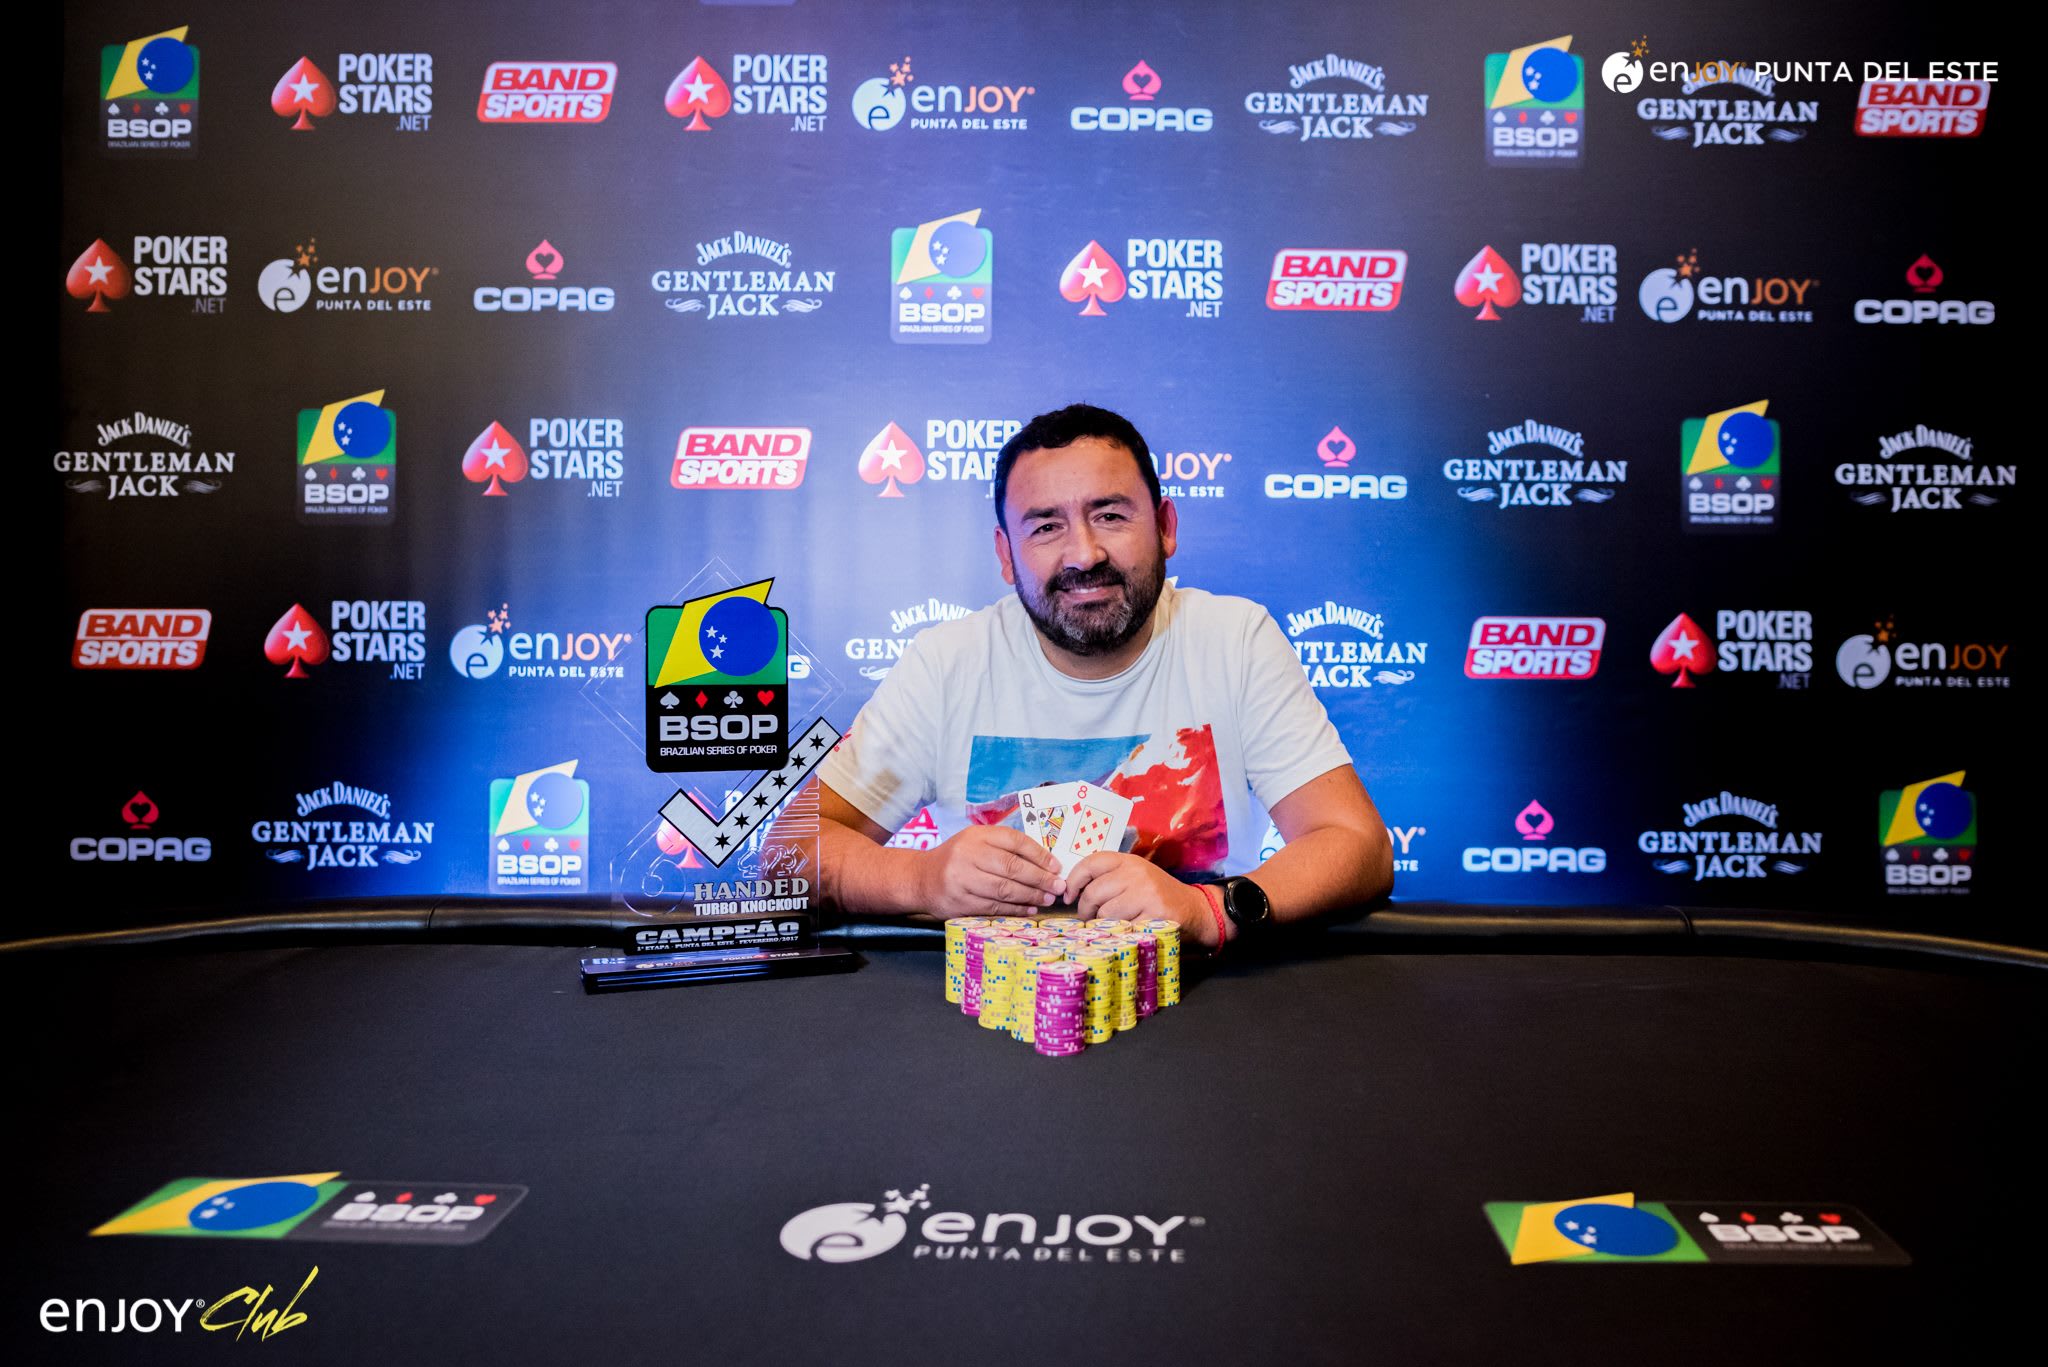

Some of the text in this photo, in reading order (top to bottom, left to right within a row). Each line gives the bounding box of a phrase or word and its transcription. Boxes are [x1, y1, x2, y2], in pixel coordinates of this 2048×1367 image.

[338, 53, 433, 83] POKER
[491, 69, 608, 91] BAND
[732, 54, 828, 84] POKER
[338, 84, 433, 114] STARS
[484, 94, 604, 119] SPORTS
[732, 85, 828, 114] STARS
[1244, 92, 1429, 116] GENTLEMAN
[1866, 84, 1982, 106] BAND
[1070, 106, 1214, 132] COPAG
[1637, 97, 1819, 122] GENTLEMAN
[1859, 109, 1979, 134] SPORTS
[107, 118, 192, 138] BSOP
[396, 115, 432, 131] .NET
[790, 115, 828, 132] .NET
[910, 118, 1028, 130] PUNTA DEL ESTE
[1300, 116, 1374, 142] JACK
[1693, 122, 1766, 148] JACK
[1493, 127, 1579, 148] BSOP
[133, 235, 228, 265] POKER
[696, 234, 734, 267] JACK
[1127, 239, 1223, 269] POKER
[1521, 243, 1617, 274] POKER
[1280, 255, 1397, 279] BAND
[134, 266, 228, 296] STARS
[651, 271, 836, 293] GENTLEMAN
[1128, 270, 1223, 300] STARS
[1522, 274, 1618, 305] STARS
[192, 298, 226, 313] .NET
[316, 300, 432, 311] PUNTA DEL ESTE
[473, 286, 615, 312] COPAG
[1273, 281, 1394, 307] SPORTS
[707, 294, 779, 320] JACK
[899, 303, 985, 323] BSOP
[1186, 301, 1223, 318] .NET
[1581, 306, 1617, 323] .NET
[1698, 310, 1813, 322] PUNTA DEL ESTE
[1854, 299, 1995, 325] COPAG
[97, 416, 133, 447] JACK
[529, 418, 624, 448] POKER
[684, 433, 803, 457] BAND
[53, 451, 236, 473] GENTLEMAN
[530, 449, 624, 480] STARS
[678, 460, 797, 485] SPORTS
[927, 450, 998, 481] STAR
[1443, 458, 1628, 483] GENTLEMAN
[1834, 463, 2017, 486] GENTLEMAN
[107, 474, 179, 500] JACK
[304, 483, 389, 504] BSOP
[587, 481, 622, 498] .NET
[1189, 486, 1225, 498] ESTE
[1264, 473, 1408, 500] COPAG
[1499, 482, 1572, 509] JACK
[1688, 493, 1775, 515] BSOP
[1891, 487, 1963, 513] JACK
[84, 614, 202, 638] BAND
[331, 600, 426, 630] POKER
[1716, 609, 1813, 640] POKER
[332, 631, 426, 662] STARS
[1479, 623, 1595, 646] BAND
[78, 641, 197, 666] SPORTS
[1470, 649, 1592, 676] SPORTS
[1717, 641, 1813, 672] STARS
[389, 663, 424, 680] .NET
[508, 665, 624, 678] PUNTA DEL ESTE
[1895, 676, 2010, 688] PUNTA DEL ESTE
[659, 714, 779, 742] BSOP
[660, 744, 778, 756] BRAZILIAN SERIES OF POKER
[296, 786, 333, 817] JACK
[1022, 793, 1035, 809] Q
[1077, 785, 1088, 799] 8
[251, 821, 435, 844] GENTLEMAN
[1638, 830, 1823, 854] GENTLEMAN
[70, 836, 212, 862] COPAG
[306, 844, 379, 871] JACK
[1462, 847, 1606, 873] COPAG
[497, 854, 582, 876] BSOP
[1694, 854, 1767, 881] JACK
[1885, 864, 1972, 885] BSOP
[693, 877, 810, 901] HANDED
[694, 896, 809, 917] TURBO KNOCKOUT
[635, 919, 800, 945] CAMPEÃO
[645, 943, 670, 951] ETAPA
[717, 939, 735, 947] ESTE
[913, 1245, 1186, 1264] PUNTA DEL ESTE
